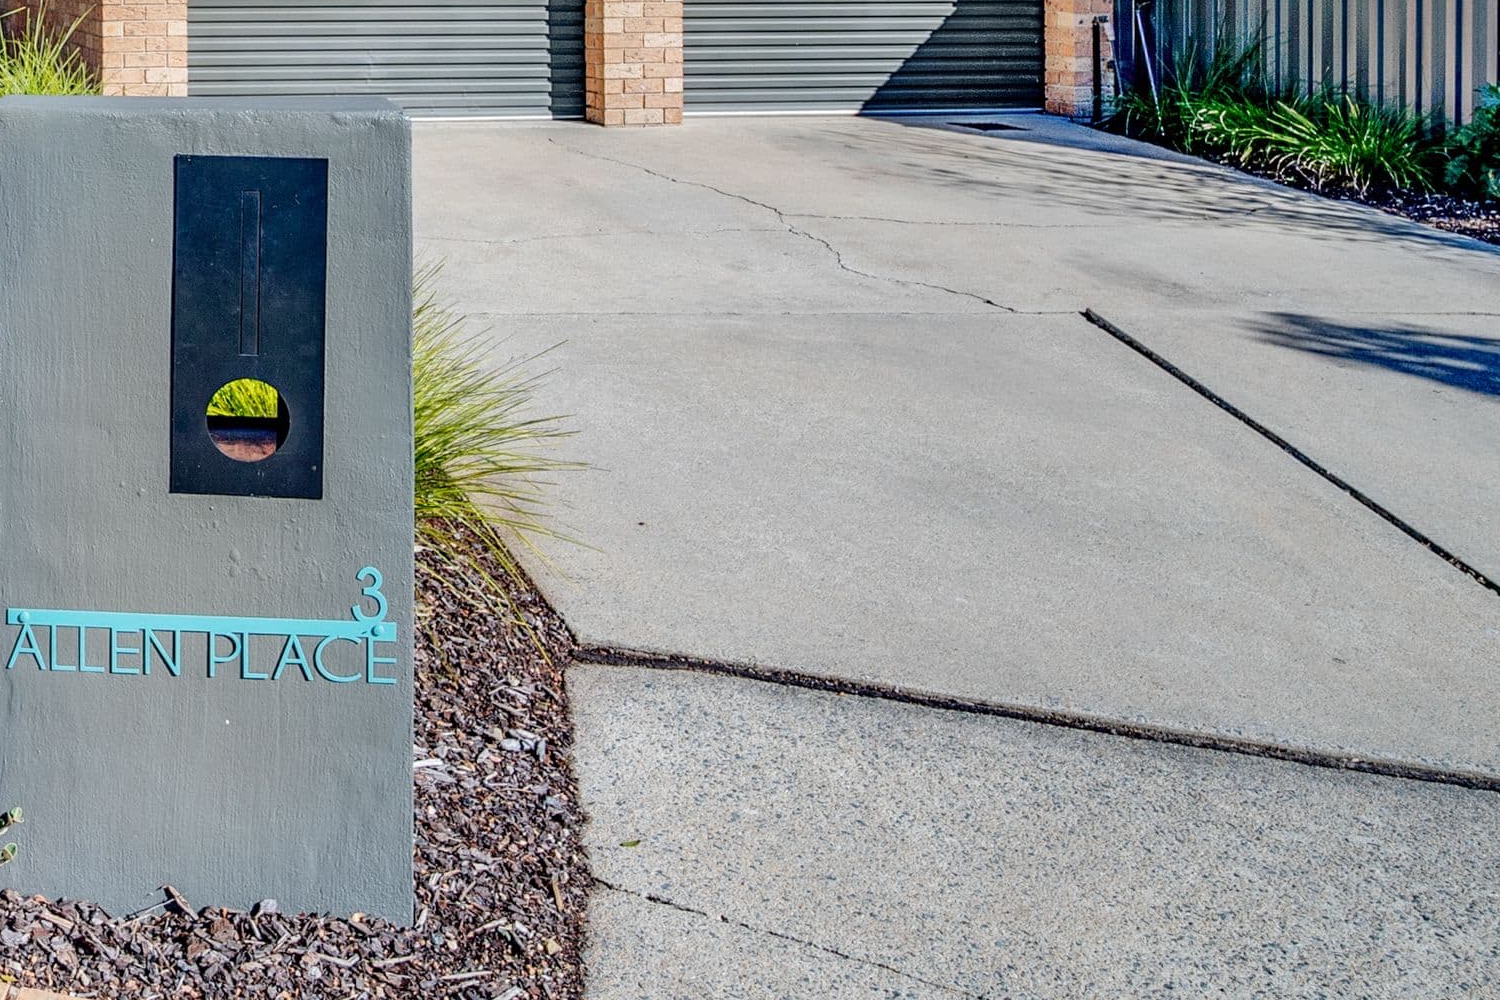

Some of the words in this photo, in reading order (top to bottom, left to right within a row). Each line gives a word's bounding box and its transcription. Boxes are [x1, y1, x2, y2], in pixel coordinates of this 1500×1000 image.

[351, 566, 388, 622] 3
[7, 624, 181, 676] ALLEN
[208, 631, 397, 684] PLACE
